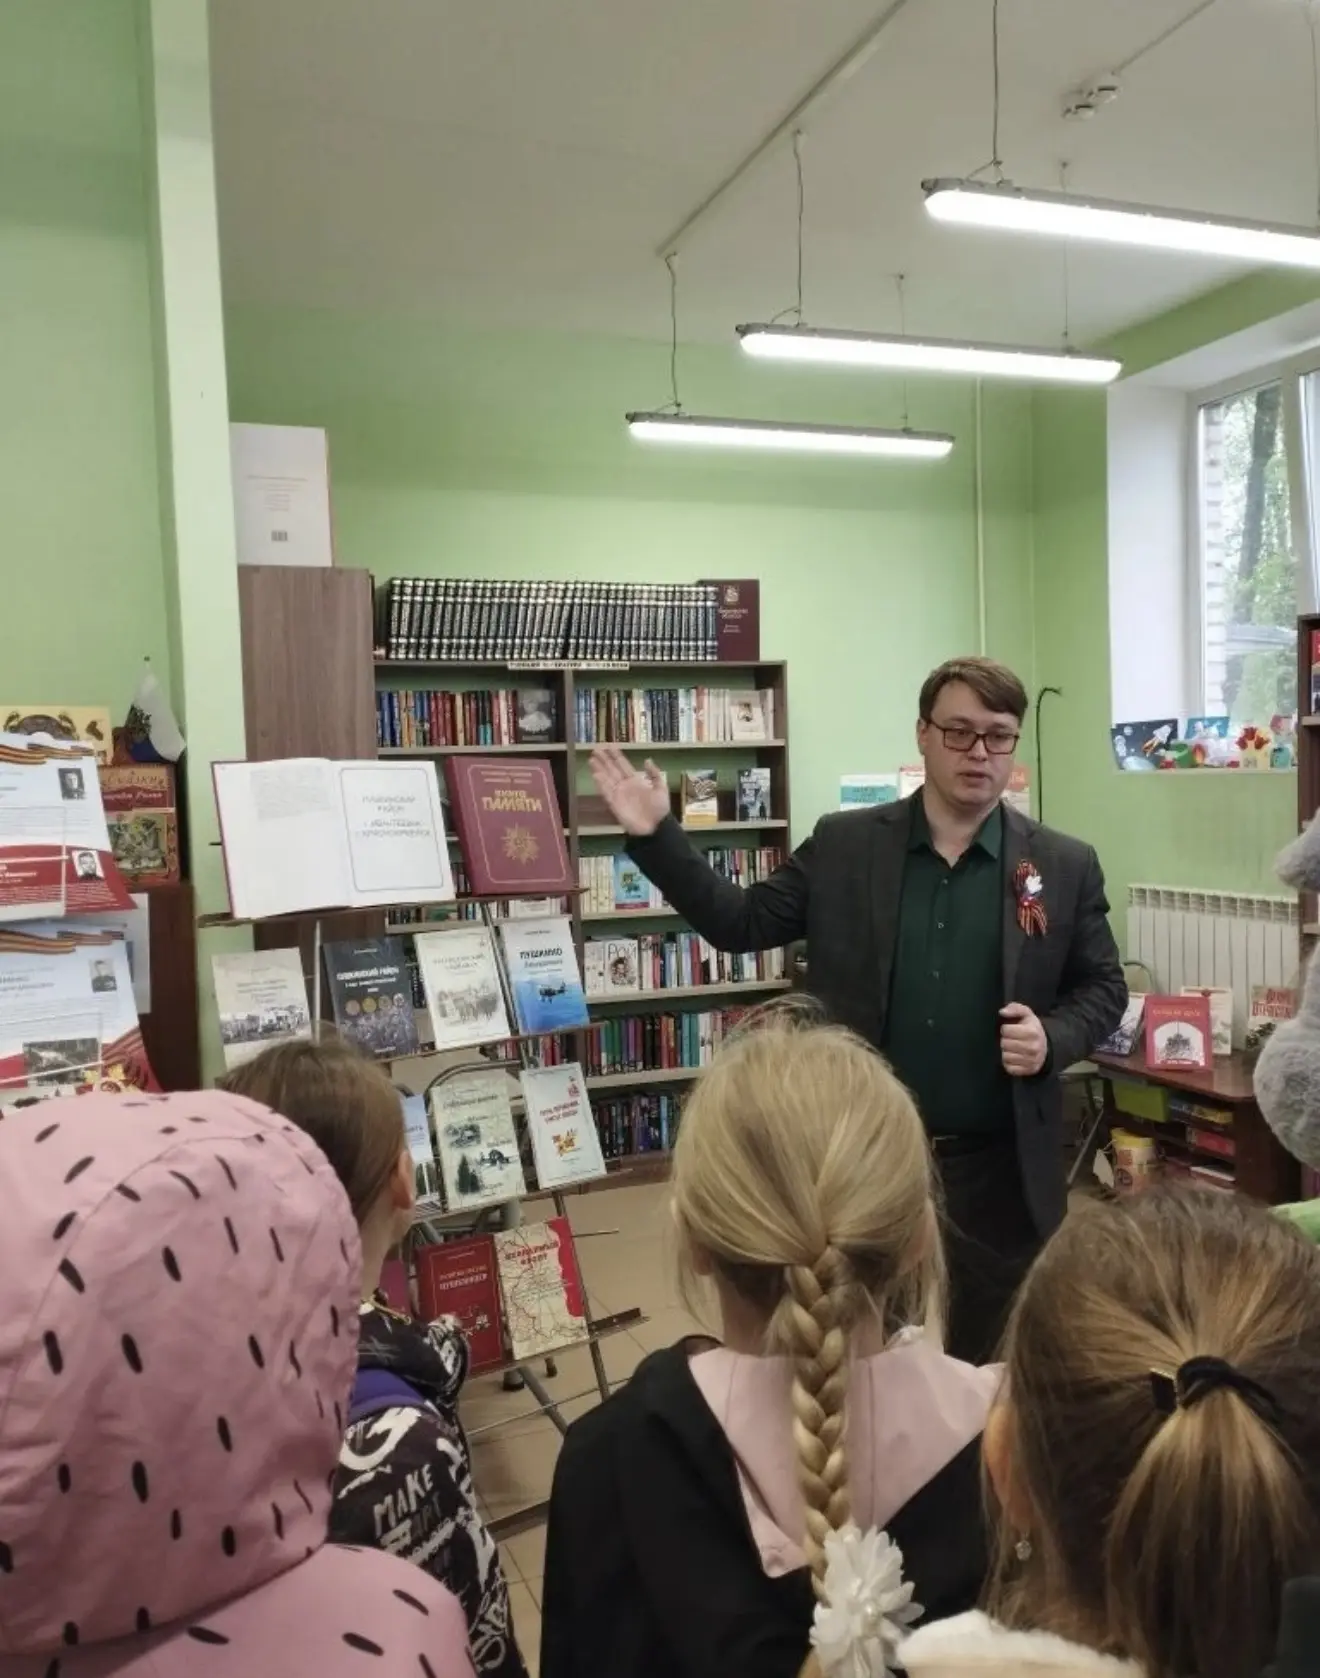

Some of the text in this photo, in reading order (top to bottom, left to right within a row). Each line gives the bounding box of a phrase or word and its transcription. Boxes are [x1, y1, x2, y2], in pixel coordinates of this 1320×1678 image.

[482, 796, 543, 812] ПАМЯТИ
[519, 947, 563, 960] ПУШКИНО
[373, 1463, 434, 1540] MAKE
